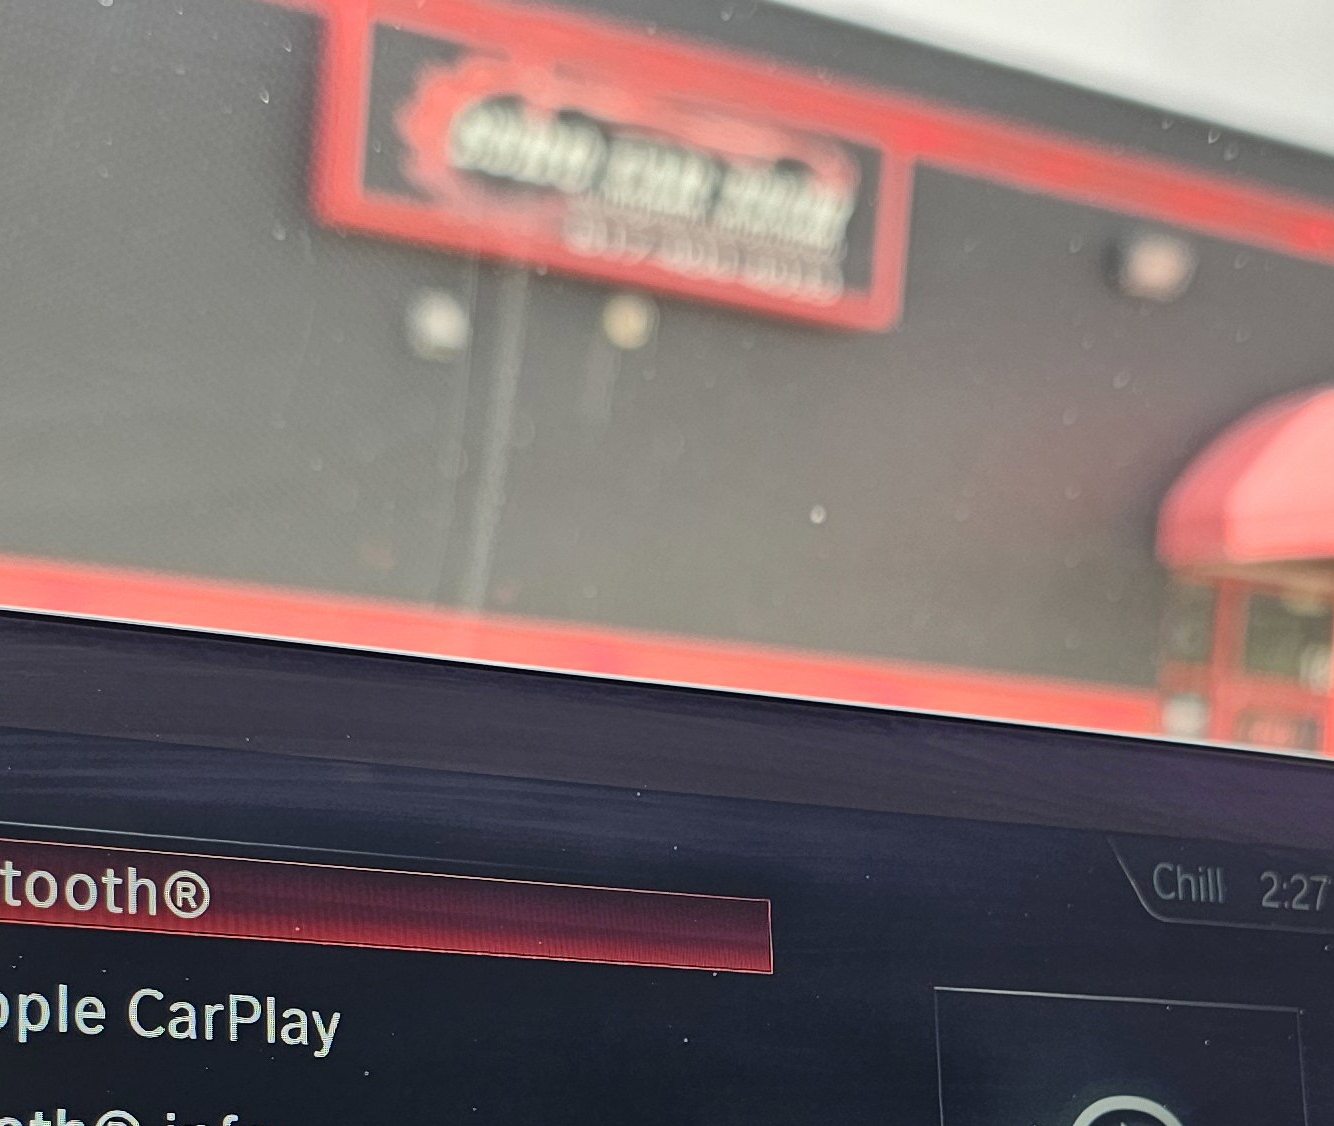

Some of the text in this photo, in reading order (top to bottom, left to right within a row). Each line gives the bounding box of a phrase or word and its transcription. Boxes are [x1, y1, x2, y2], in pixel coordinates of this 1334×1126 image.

[1152, 862, 1224, 904] Chill
[1260, 871, 1331, 911] 2:27
[127, 987, 342, 1058] CarPlay
